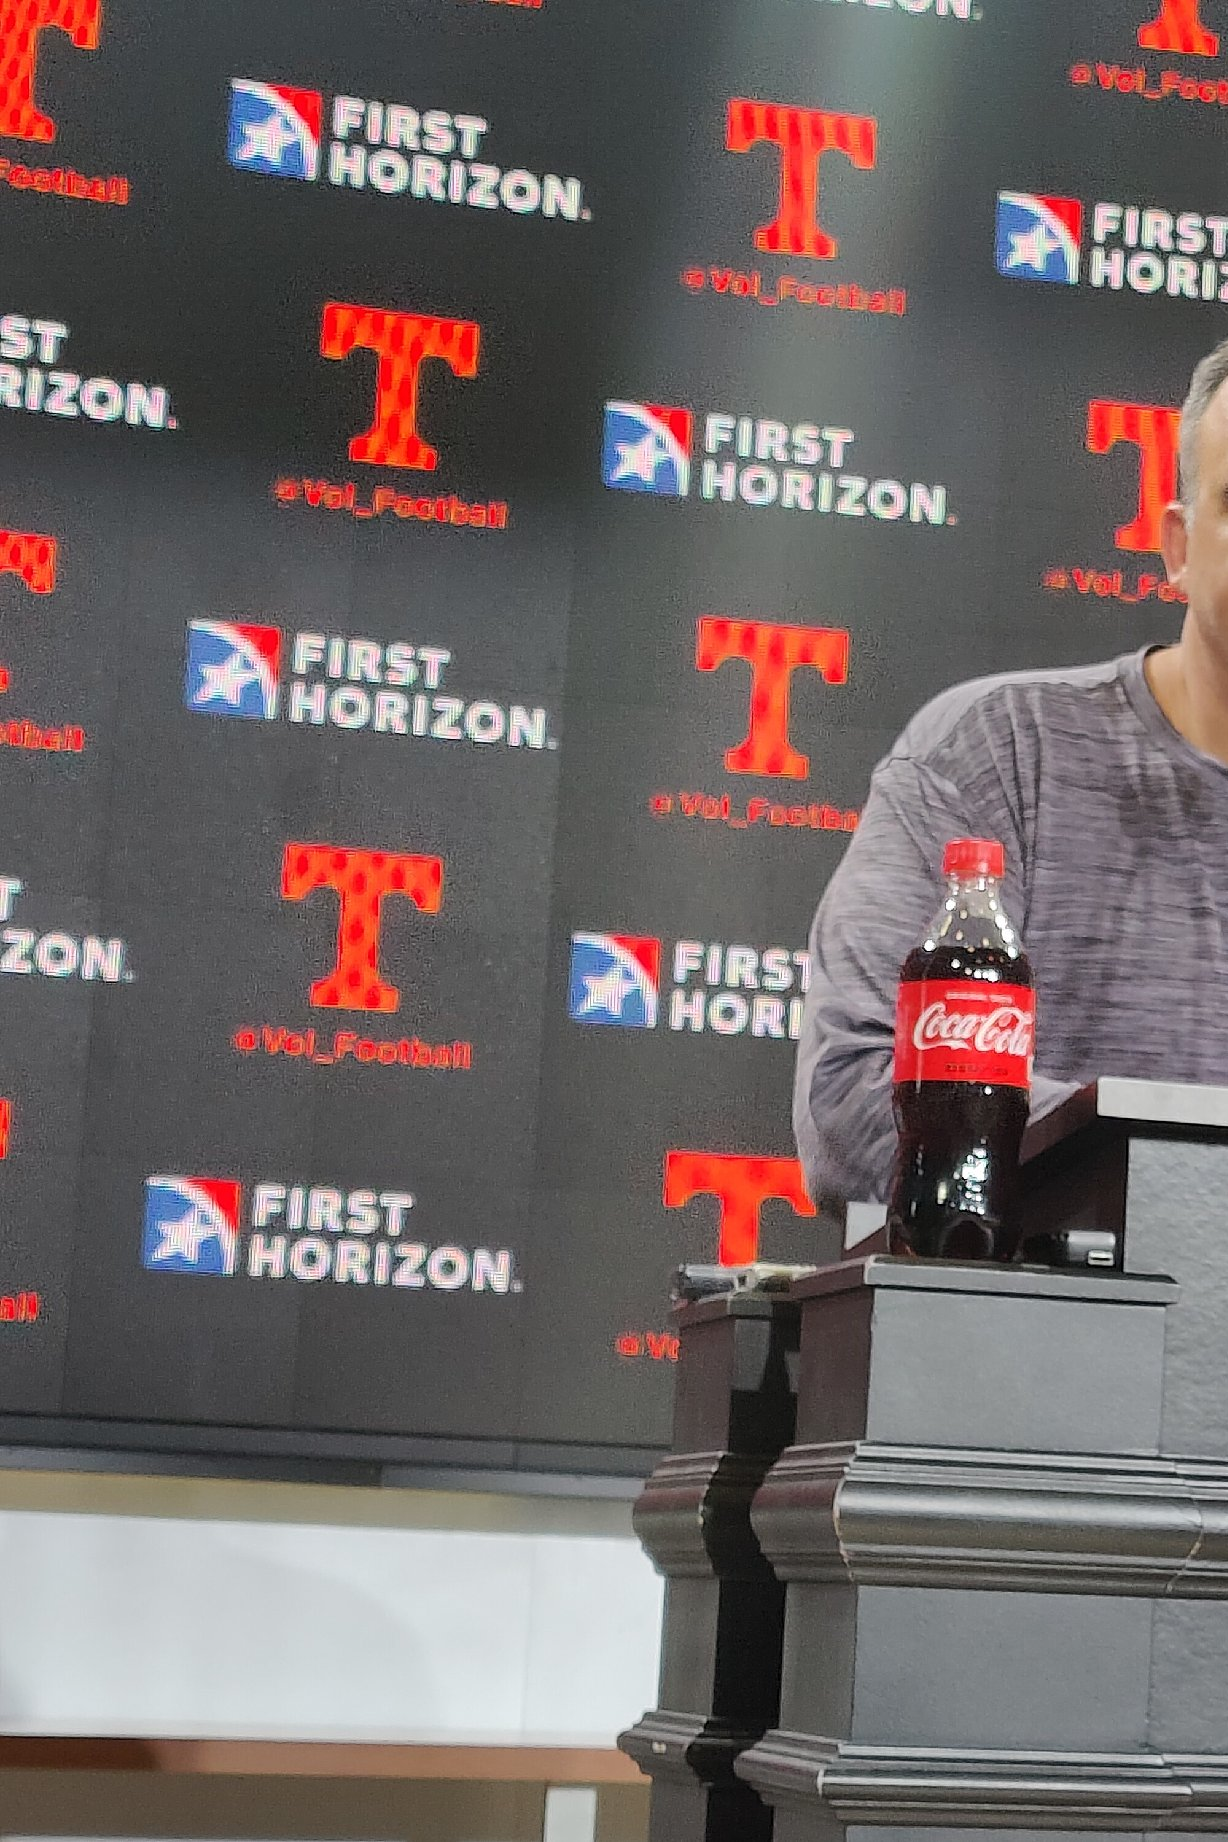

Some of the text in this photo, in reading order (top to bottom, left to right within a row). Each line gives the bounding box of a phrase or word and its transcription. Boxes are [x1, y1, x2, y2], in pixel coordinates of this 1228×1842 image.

[331, 94, 489, 160] FIRST
[681, 267, 907, 316] @Vol_Football
[704, 412, 855, 469] FIRST
[274, 478, 509, 529] @Vol_Football
[291, 631, 452, 690] FIRST
[673, 939, 812, 993] FIRST
[669, 988, 802, 1041] HORI
[233, 1024, 473, 1070] @Vol_Football
[251, 1182, 416, 1237] FIRST
